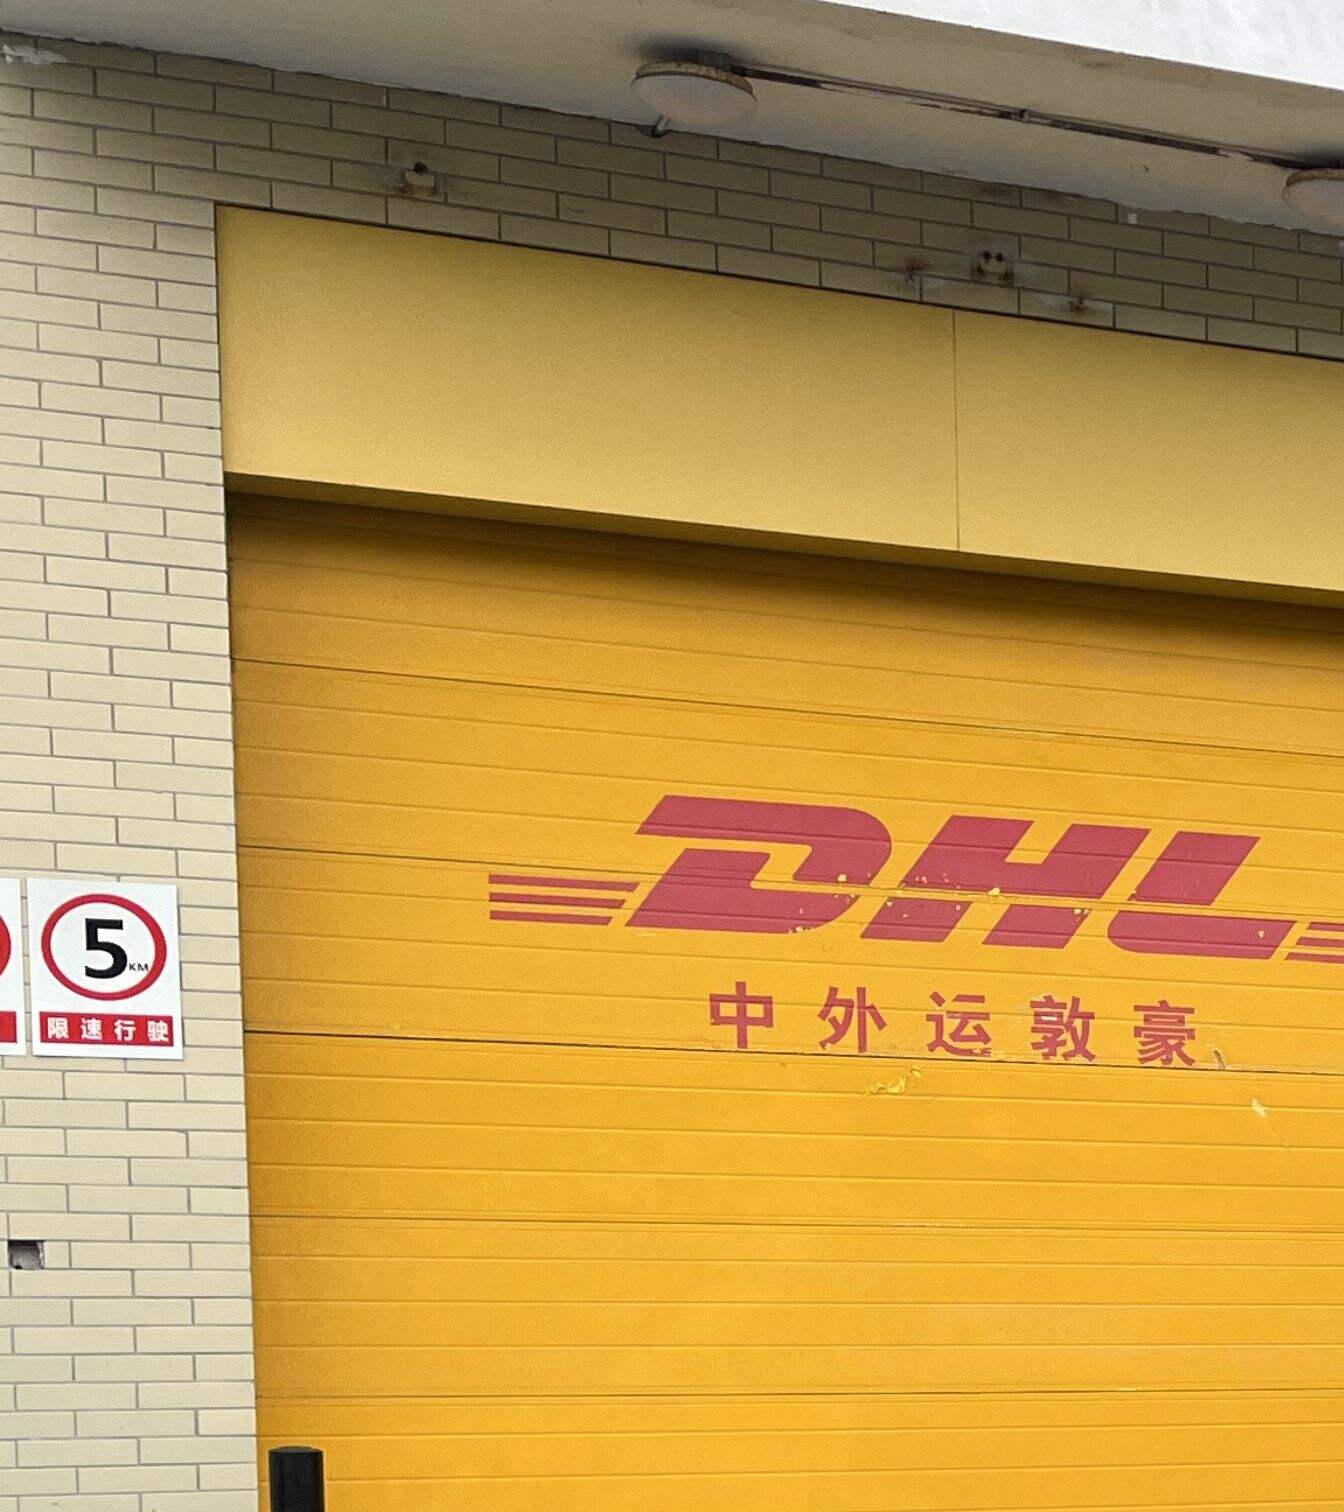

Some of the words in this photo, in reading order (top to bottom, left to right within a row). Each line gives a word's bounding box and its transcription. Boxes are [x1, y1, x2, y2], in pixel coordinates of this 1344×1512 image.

[625, 794, 1298, 961] DHL
[84, 917, 128, 979] 5
[47, 1016, 170, 1043] 限速行驶
[708, 981, 1198, 1067] 中外运敦豪
